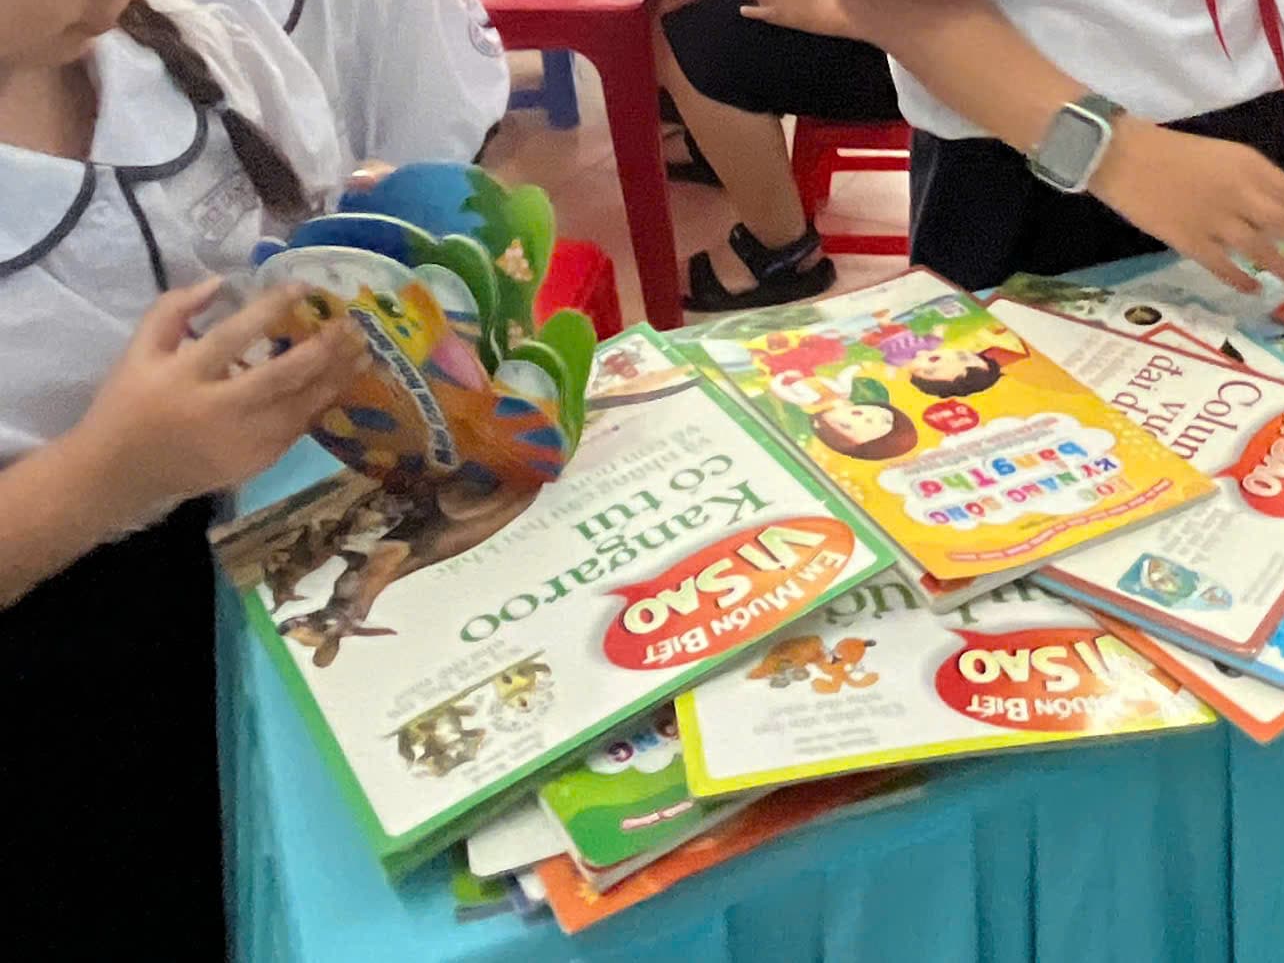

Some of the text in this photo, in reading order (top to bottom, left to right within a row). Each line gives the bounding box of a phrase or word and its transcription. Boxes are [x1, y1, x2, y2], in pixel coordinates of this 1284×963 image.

[669, 453, 733, 494] có
[920, 468, 998, 499] Thơ
[574, 490, 664, 544] túi
[460, 480, 774, 643] Kangaroo
[736, 526, 827, 572] VÌ
[799, 550, 848, 585] EM
[622, 558, 752, 634] SAO
[710, 580, 805, 637] MUỐN
[642, 626, 709, 664] BIẾT
[958, 645, 1080, 693] SAO
[967, 695, 1030, 722] BIẾT
